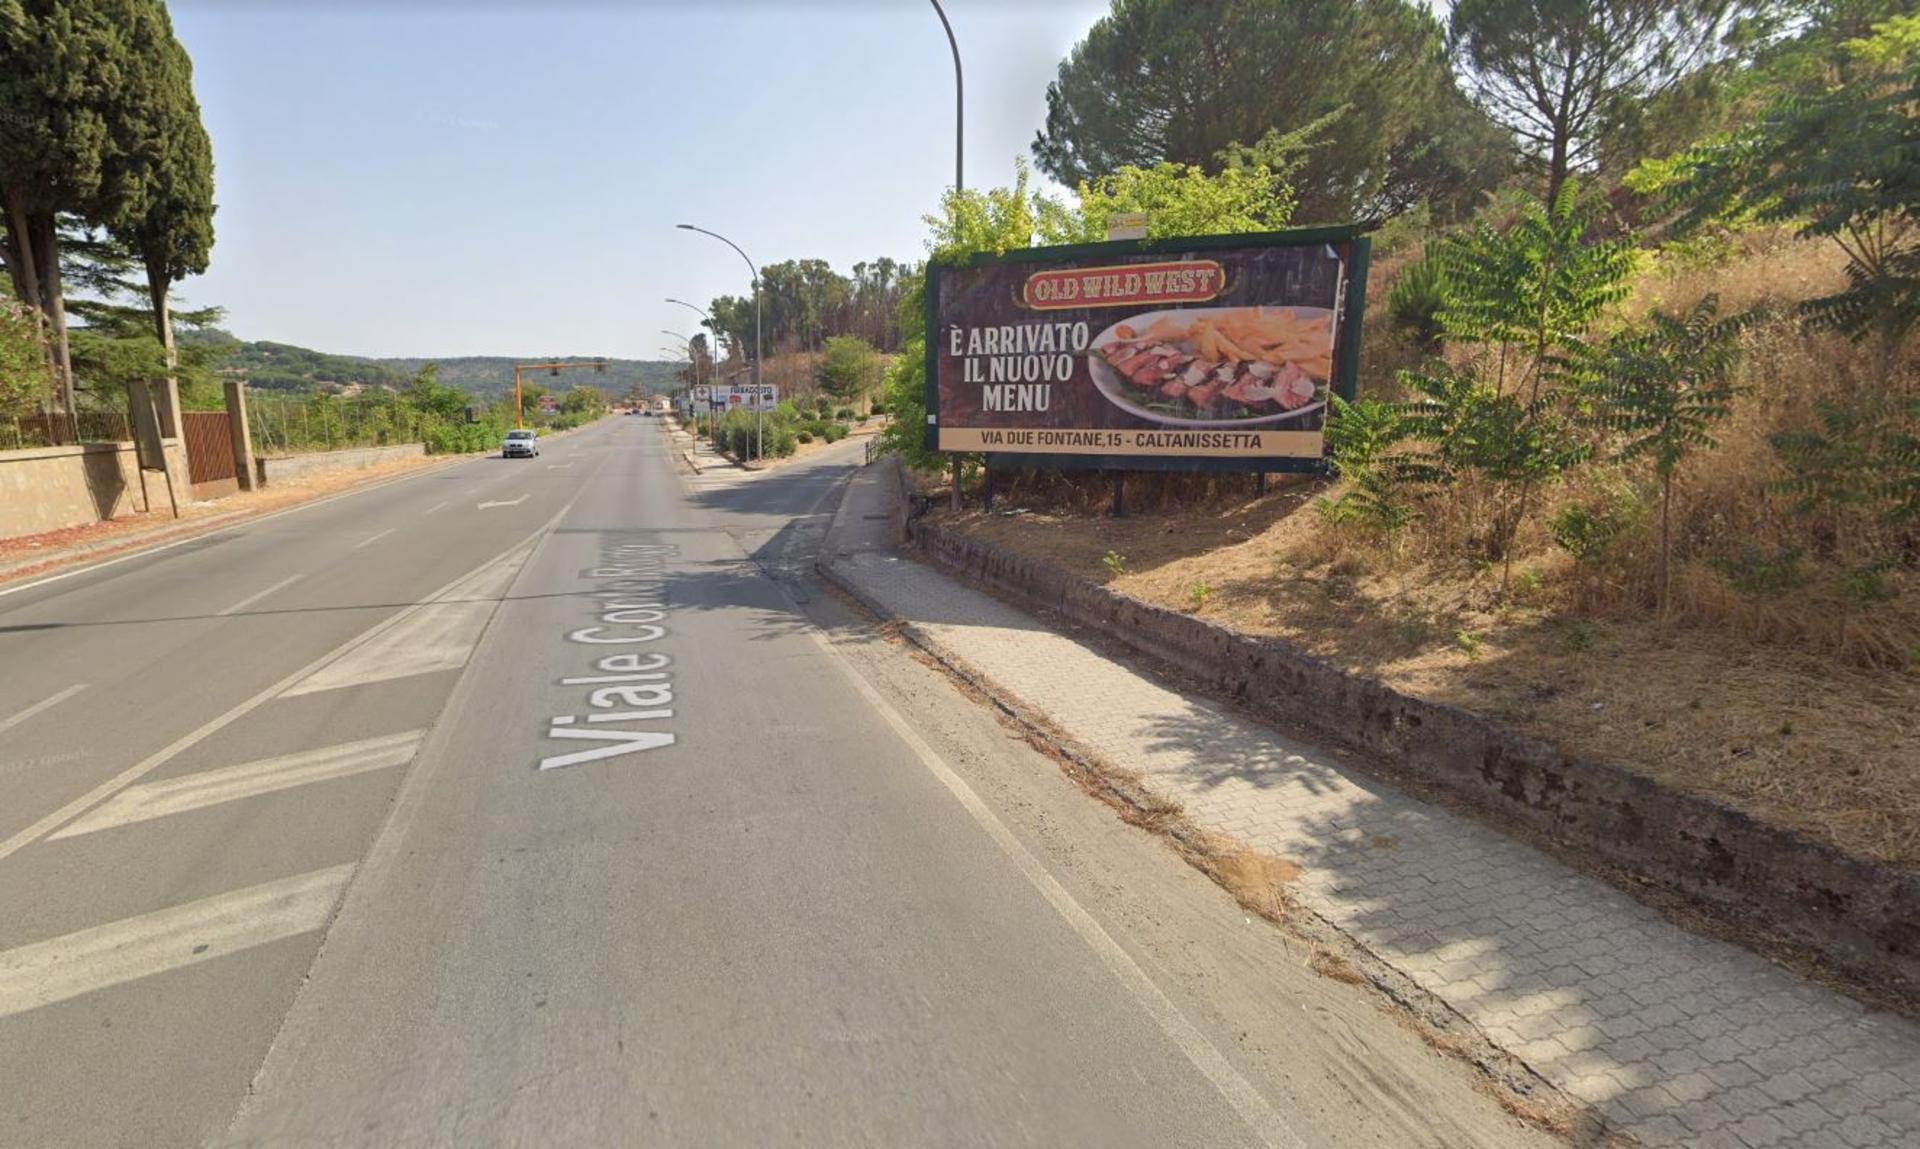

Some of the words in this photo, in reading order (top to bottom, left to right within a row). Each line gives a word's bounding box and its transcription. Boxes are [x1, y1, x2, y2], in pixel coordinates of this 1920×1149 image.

[1035, 277, 1079, 300] OLD
[1082, 273, 1141, 298] WILD
[1144, 269, 1215, 295] WEST
[950, 324, 963, 356] È
[968, 321, 1089, 355] ARRIVATO
[964, 357, 984, 382] IL
[989, 353, 1074, 382] NUOVO
[982, 383, 1051, 412] MENU
[981, 431, 1002, 445] VIA
[1007, 431, 1034, 445] DUE
[1136, 433, 1262, 449] CALTANISSETTA
